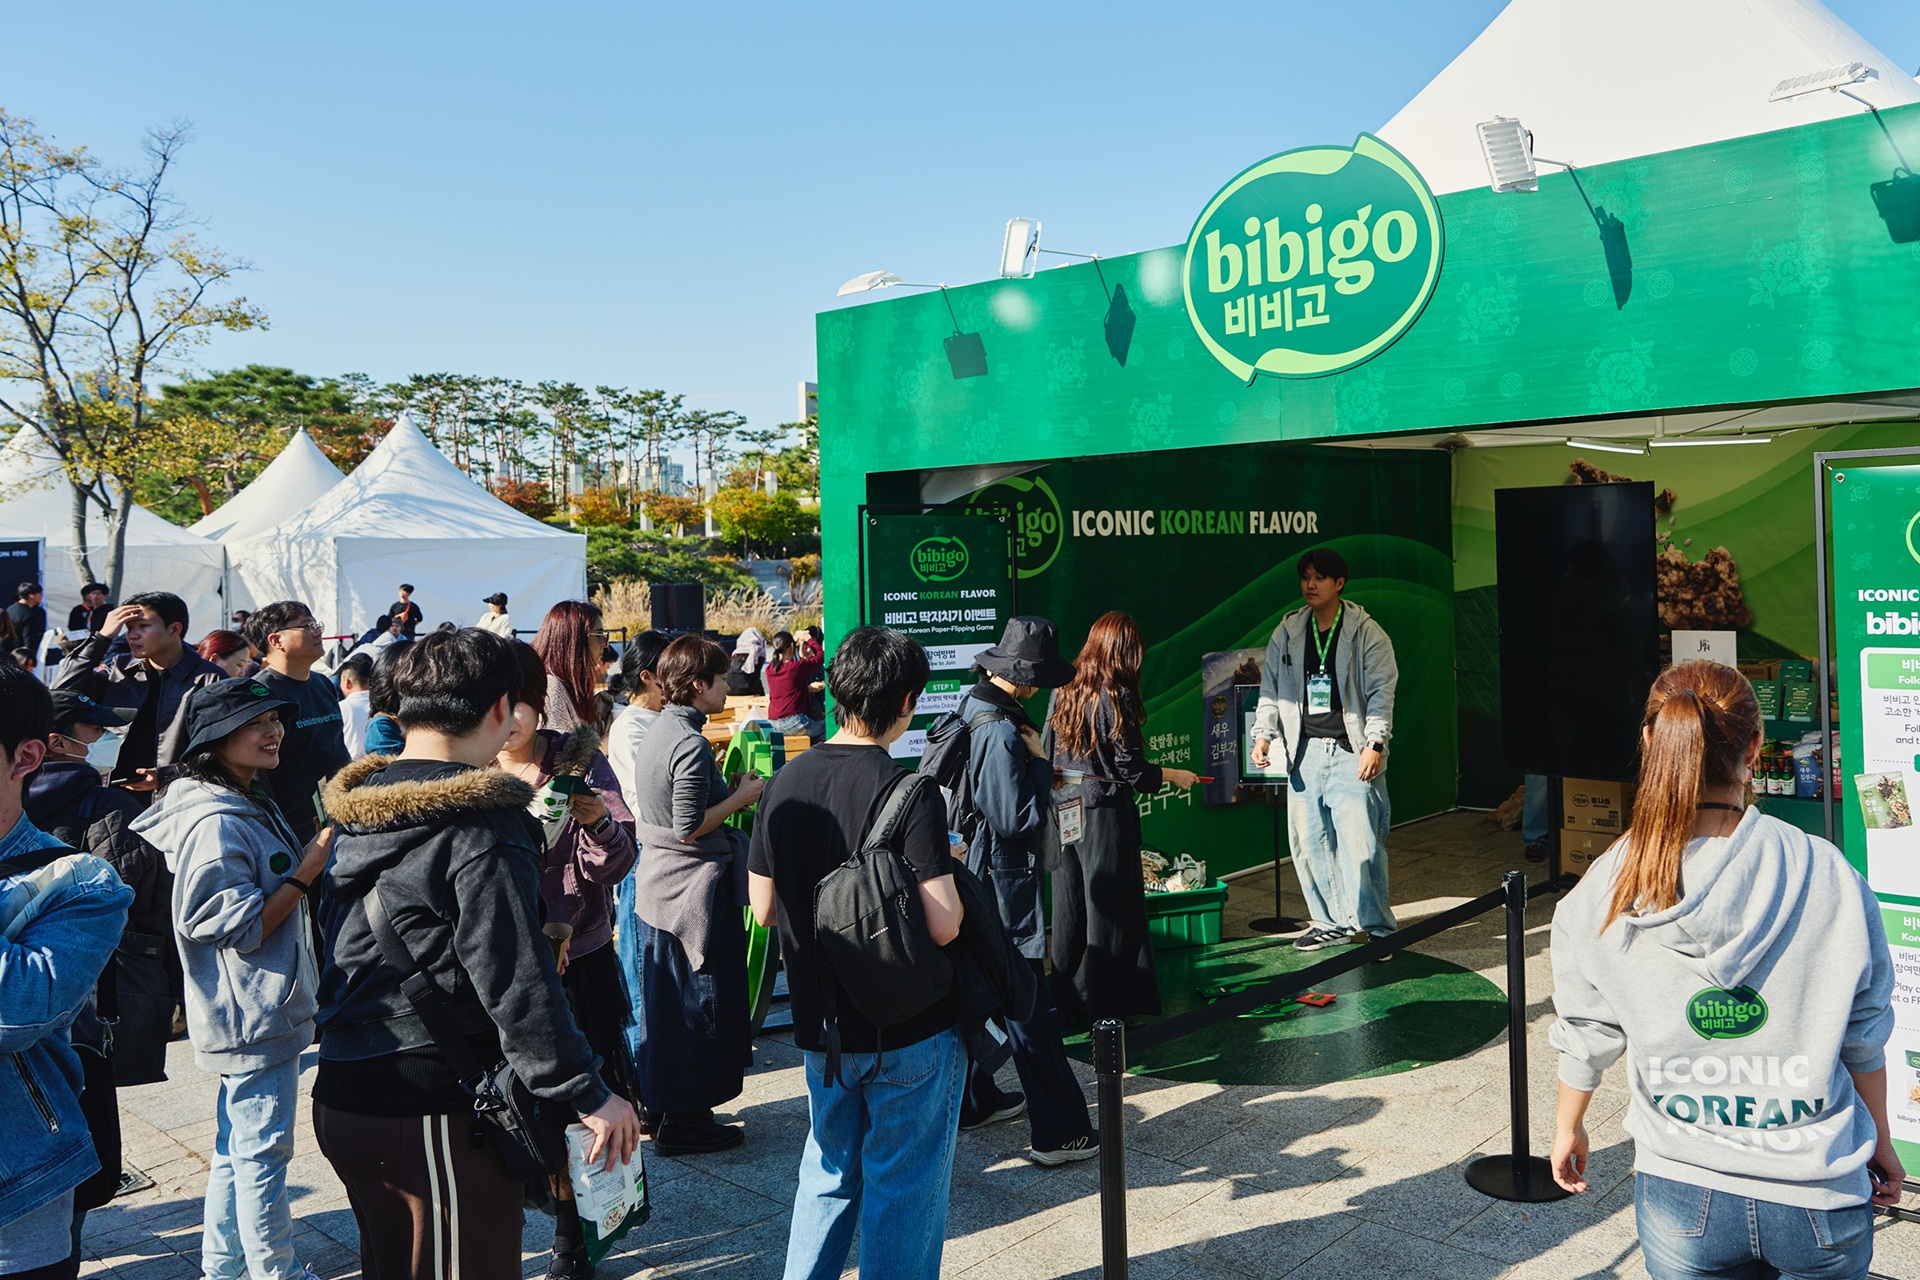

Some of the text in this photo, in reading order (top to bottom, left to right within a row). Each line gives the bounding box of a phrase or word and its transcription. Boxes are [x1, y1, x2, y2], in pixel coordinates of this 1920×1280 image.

[1205, 203, 1418, 295] bibigo
[1223, 284, 1330, 338] 비비고
[1072, 509, 1319, 537] ICONIC KOREAN FLAVOR
[917, 547, 965, 568] bibigo
[919, 562, 947, 573] 비비고
[883, 589, 996, 601] ICONIC KOREAN FLAVOR
[1858, 589, 1920, 602] ICONIC
[884, 608, 997, 625] 비비고 딱지치기 이벤트
[1866, 611, 1920, 636] bibi
[908, 627, 931, 635] Korean
[931, 624, 976, 634] Paper-Flipping
[1883, 695, 1910, 704] 비비고
[1884, 707, 1911, 717] 고소한
[1211, 722, 1230, 738] 새우
[1895, 736, 1914, 744] and
[1211, 740, 1237, 760] 김부각
[1694, 1000, 1762, 1023] bibigo
[1701, 1018, 1736, 1030] 비비고
[1649, 1055, 1809, 1088] ICONIC
[1897, 1113, 1917, 1123] bibigo
